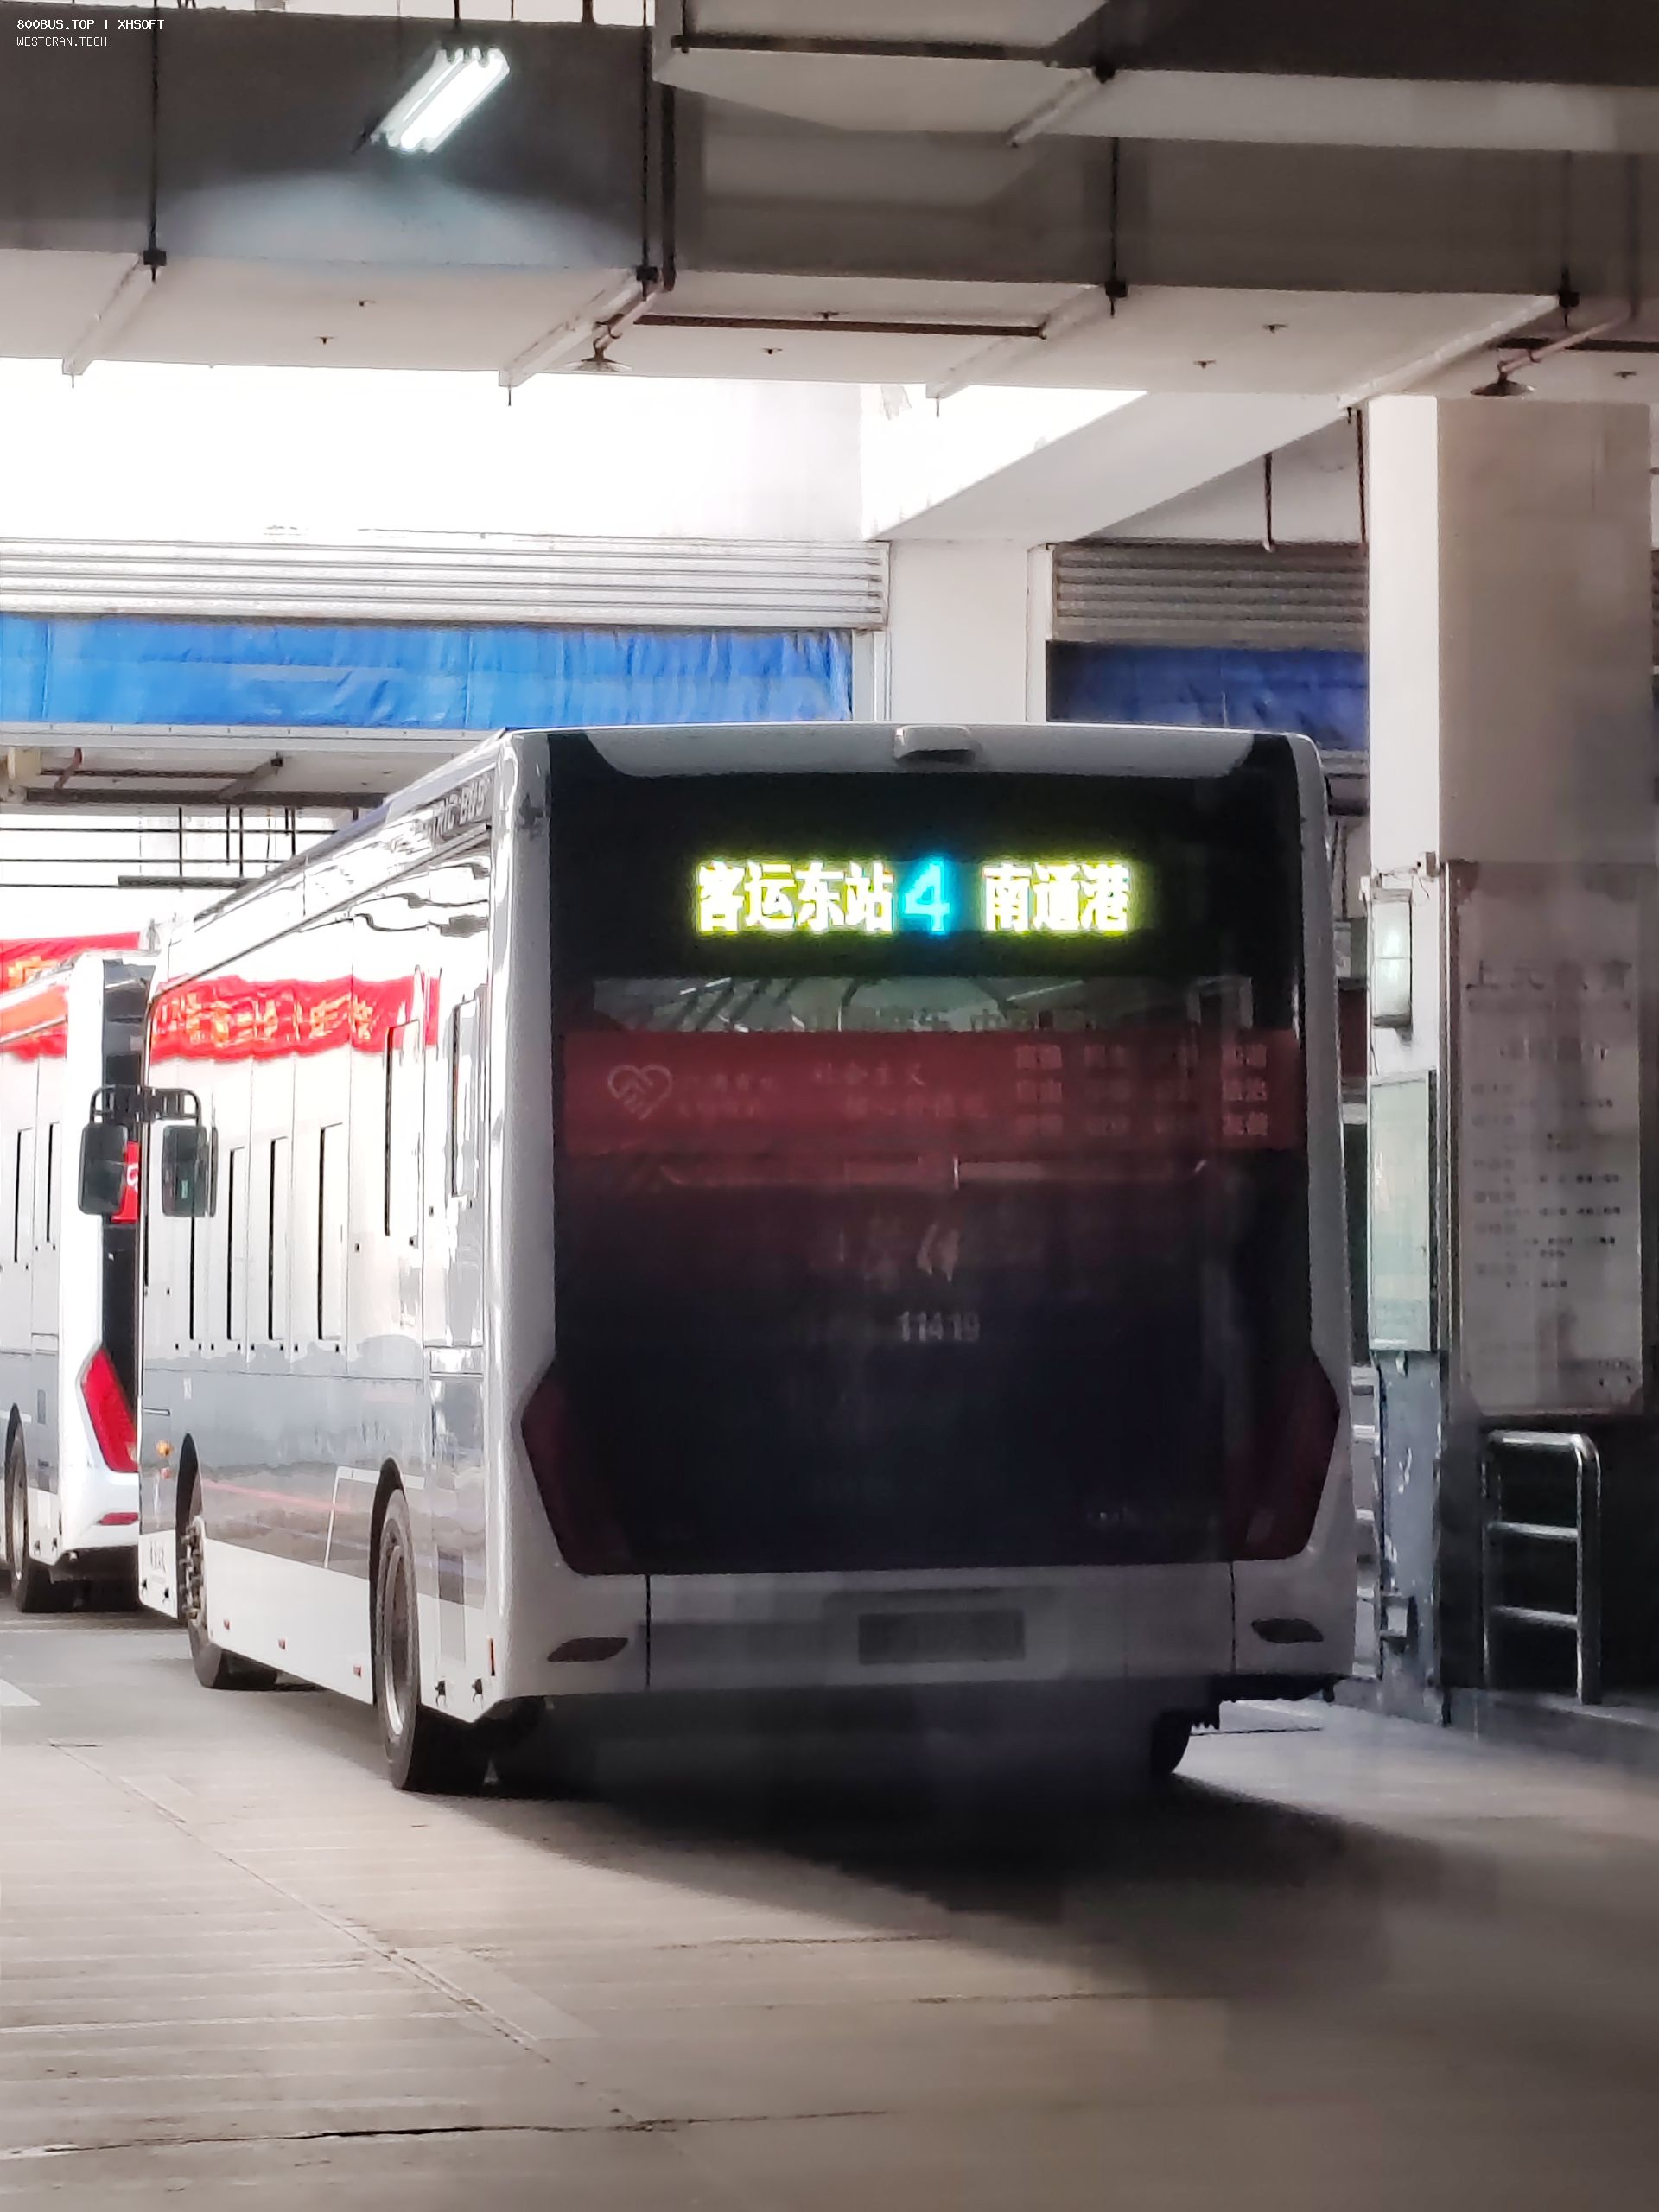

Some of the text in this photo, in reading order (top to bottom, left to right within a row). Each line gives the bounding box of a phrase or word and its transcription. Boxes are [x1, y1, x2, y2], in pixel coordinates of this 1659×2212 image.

[696, 858, 1130, 935] 客运东站 4 南通港
